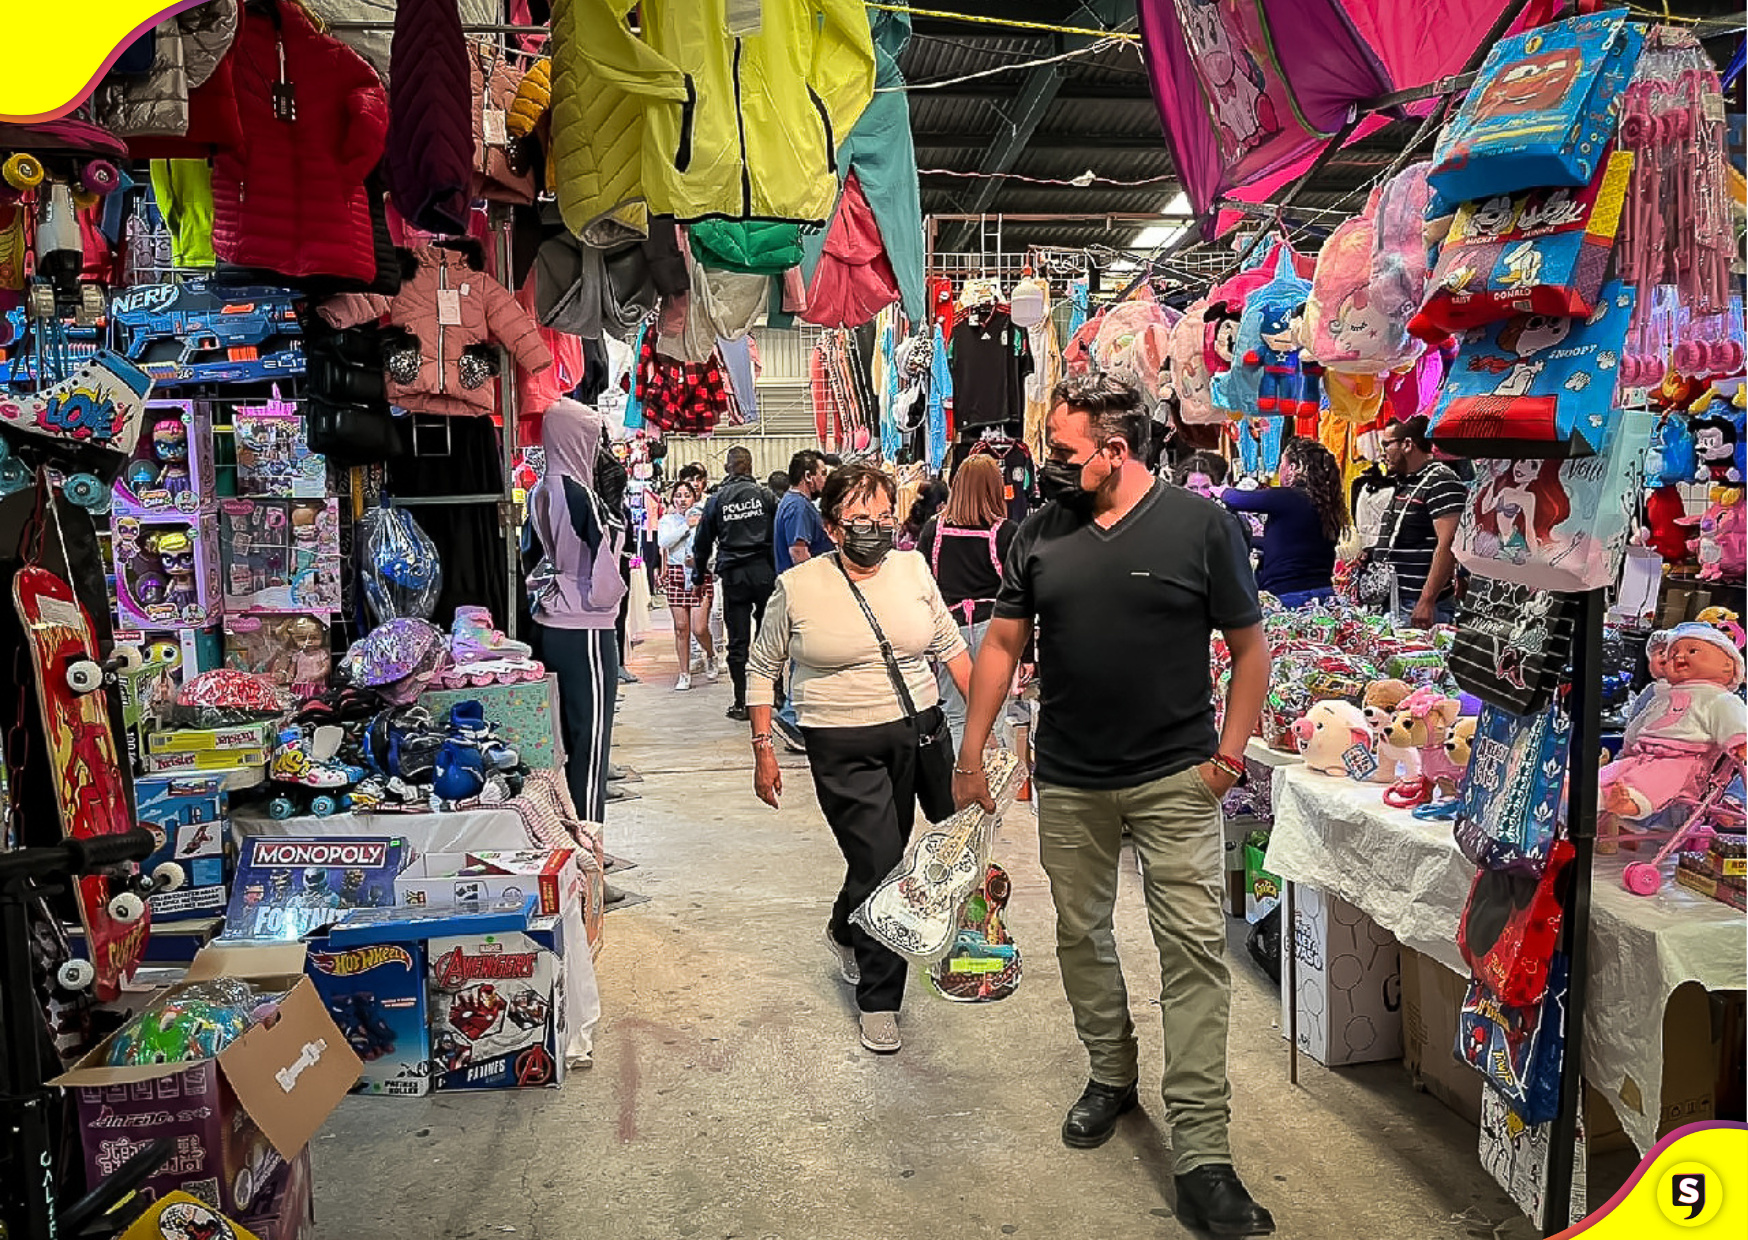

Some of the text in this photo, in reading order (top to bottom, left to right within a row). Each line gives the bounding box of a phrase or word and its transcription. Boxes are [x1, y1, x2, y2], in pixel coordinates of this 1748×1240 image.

[112, 284, 176, 315] NERF
[1493, 289, 1531, 301] DONALD
[1548, 344, 1598, 359] SNOOPY
[262, 356, 307, 369] ELIT
[46, 394, 114, 438] LOVE
[722, 498, 763, 514] POLICÍA
[216, 732, 256, 745] Twister
[155, 756, 195, 769] Twister
[257, 845, 382, 864] MONOPOLY
[254, 905, 350, 935] FORTNIT
[434, 946, 538, 988] AVENGERS
[467, 1060, 506, 1082] PATINES
[384, 1080, 418, 1088] PATINES
[41, 1151, 57, 1240] CALIF
